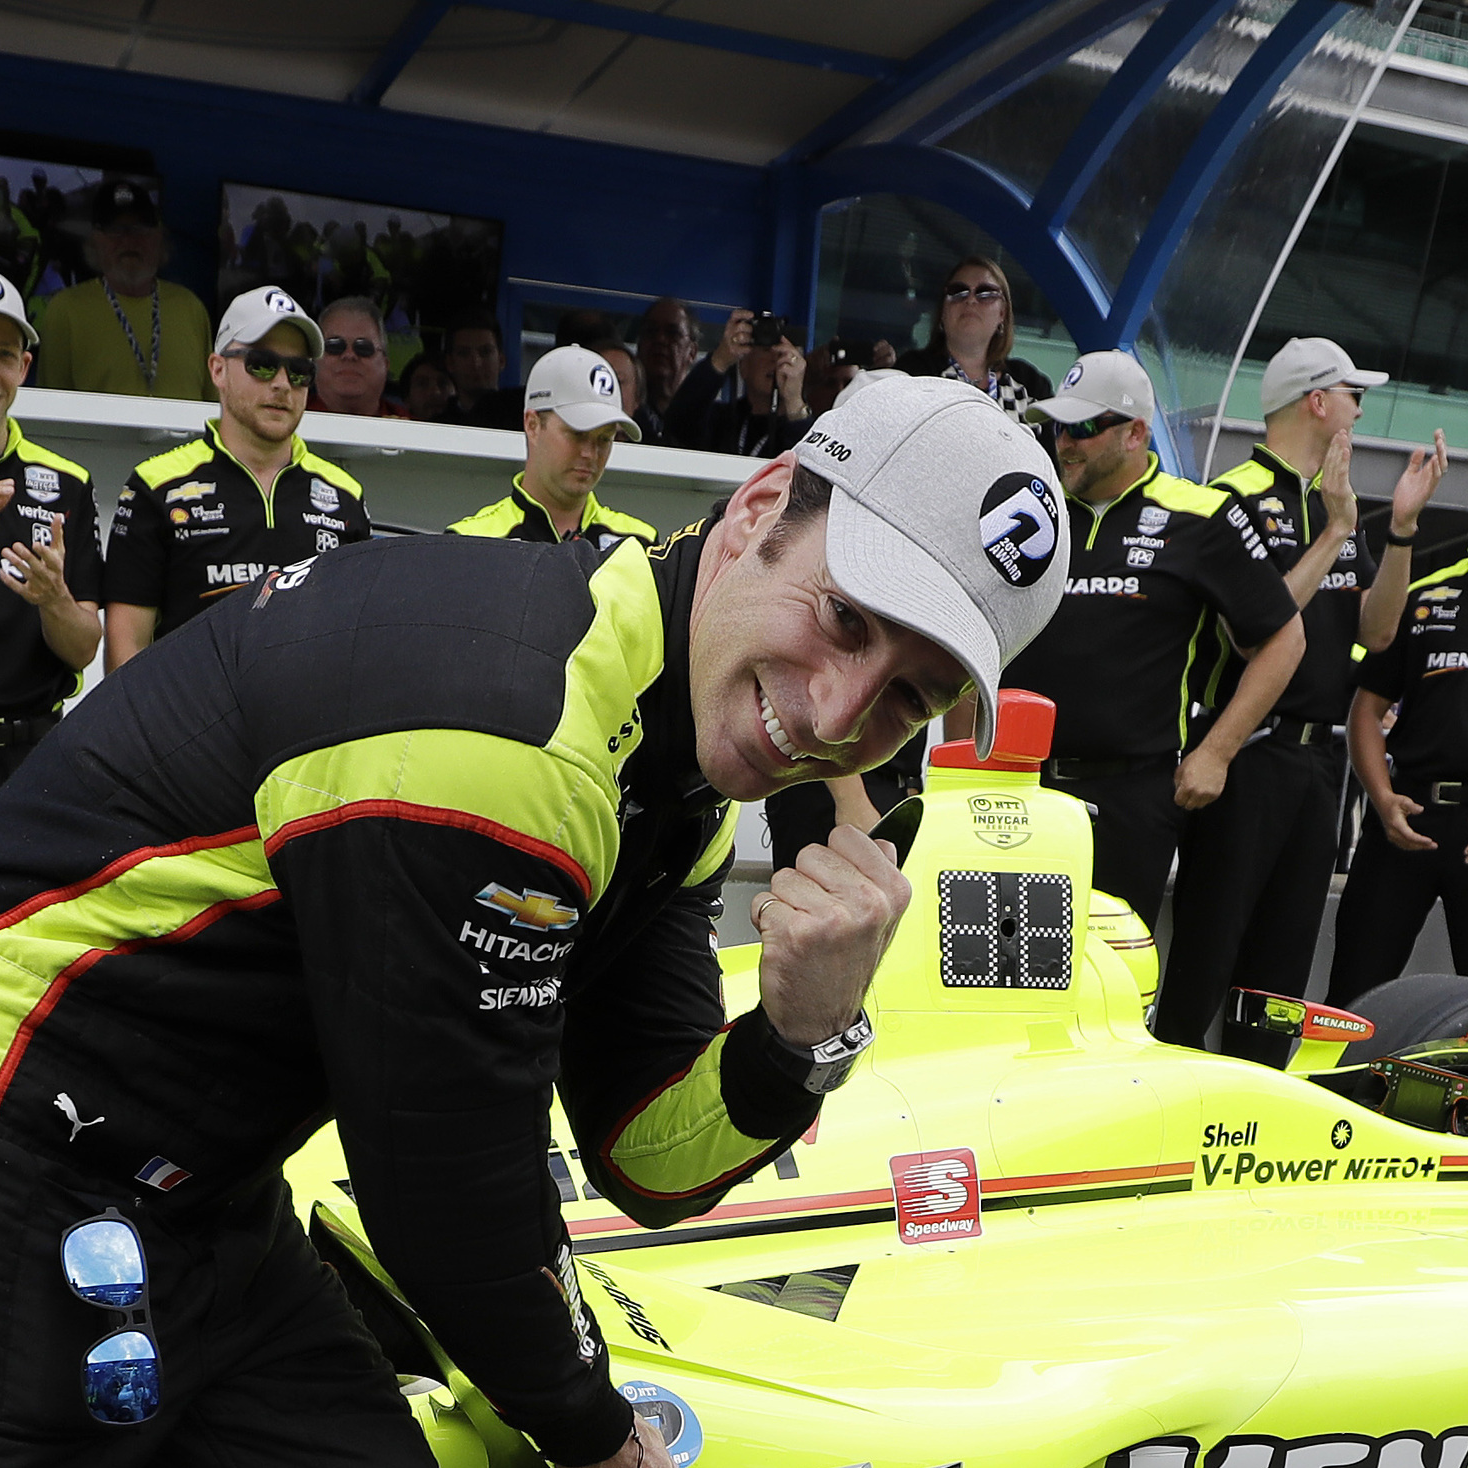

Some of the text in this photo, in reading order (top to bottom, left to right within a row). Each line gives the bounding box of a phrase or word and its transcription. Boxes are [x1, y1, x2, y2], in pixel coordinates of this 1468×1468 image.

[825, 441, 852, 462] 500
[302, 512, 346, 532] verizon
[999, 537, 1021, 561] 2019
[1122, 534, 1164, 549] verizon
[988, 544, 1022, 582] AWARD
[1128, 550, 1155, 566] PPG
[1064, 576, 1140, 595] NARDS
[995, 800, 1021, 810] NTT
[973, 814, 1030, 826] INDYCAR
[1311, 1014, 1367, 1034] MENARDS
[1202, 1121, 1258, 1149] Shell
[1201, 1152, 1338, 1187] V-Power
[903, 1216, 976, 1240] Speedway
[637, 1386, 658, 1397] NTT
